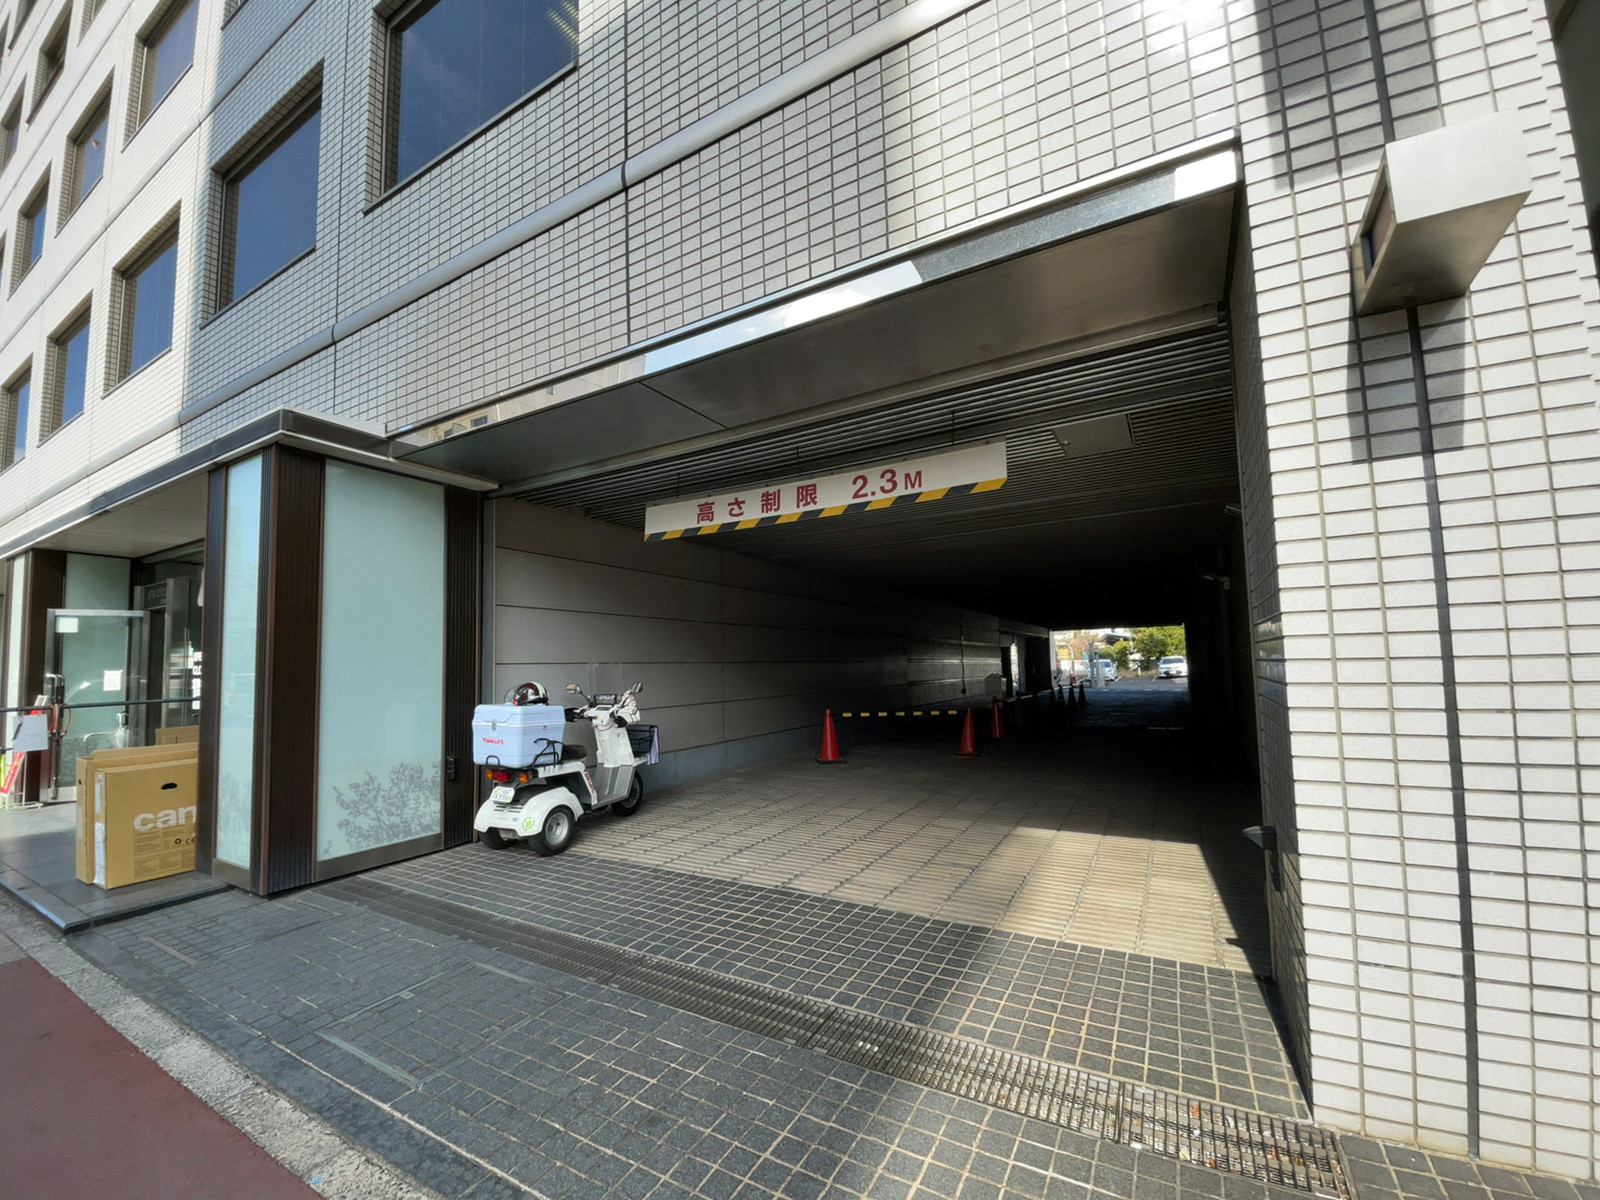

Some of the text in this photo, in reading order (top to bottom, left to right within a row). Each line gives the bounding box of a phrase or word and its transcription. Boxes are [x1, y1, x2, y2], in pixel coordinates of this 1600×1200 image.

[696, 483, 818, 524] 高さ制限
[482, 737, 505, 745] Yakult
